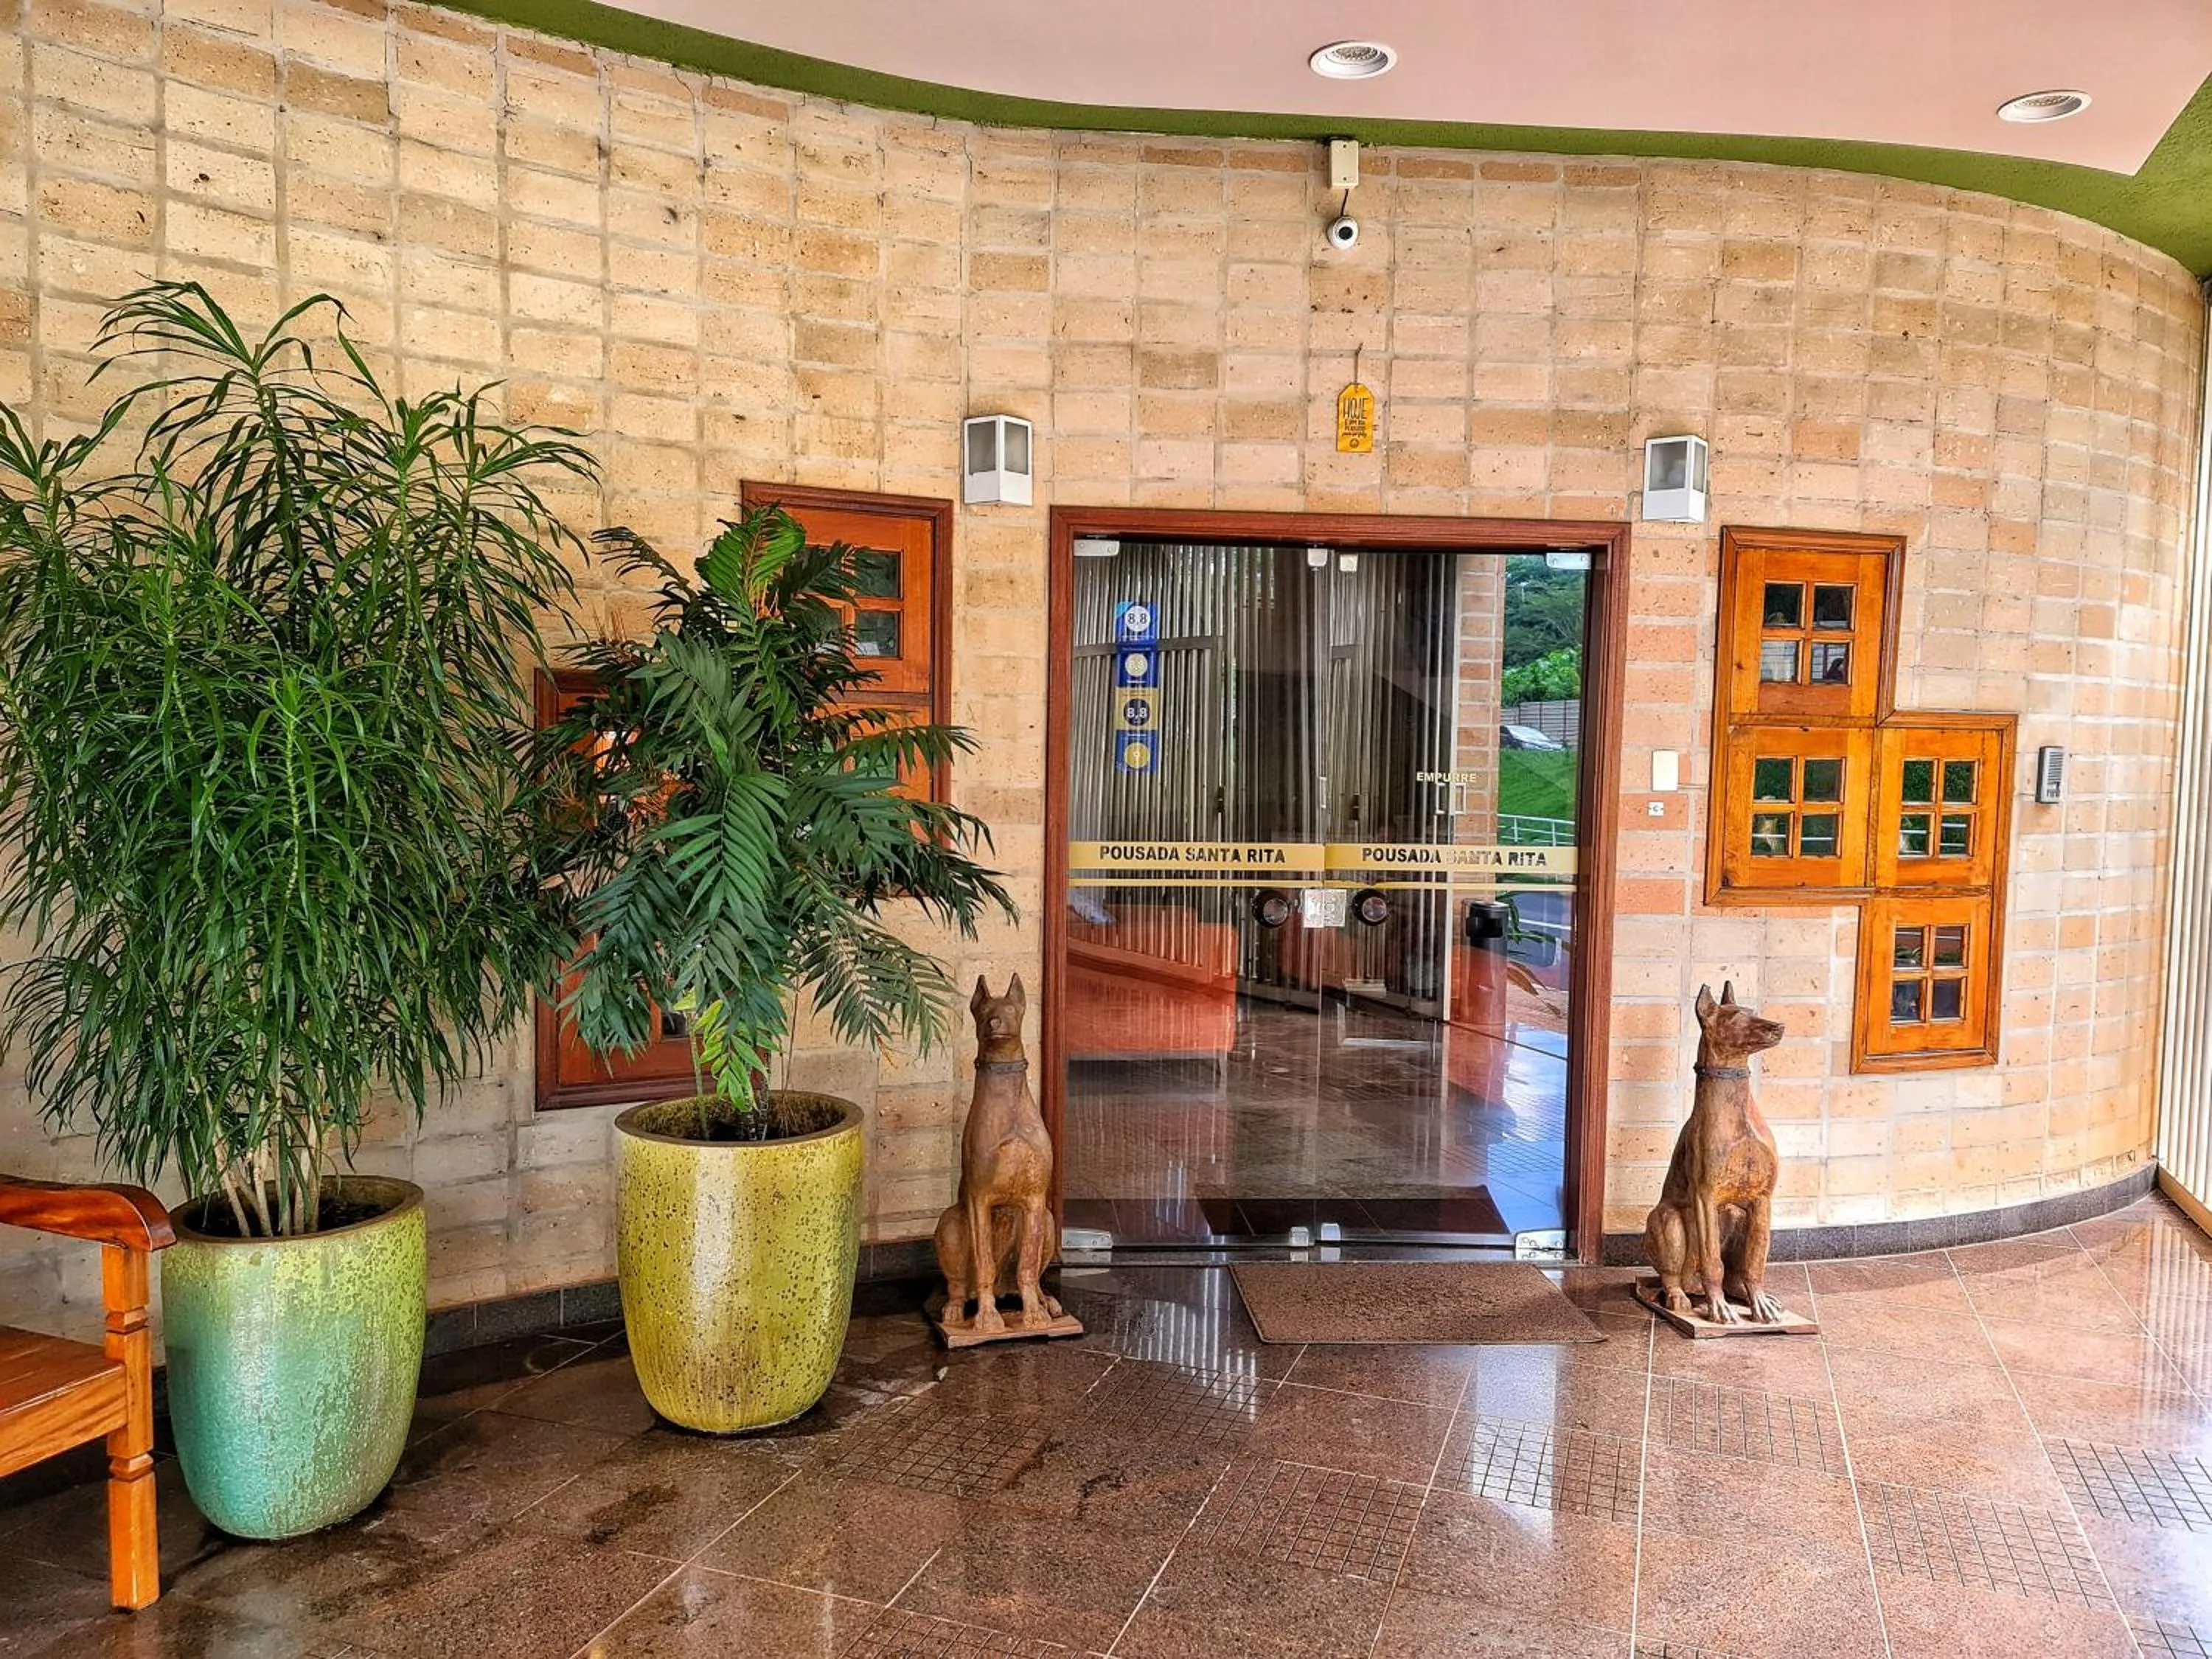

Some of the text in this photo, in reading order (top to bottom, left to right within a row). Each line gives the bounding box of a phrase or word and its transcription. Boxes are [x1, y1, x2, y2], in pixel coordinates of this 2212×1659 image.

[1343, 397, 1369, 420] HOJE
[1127, 613, 1148, 625] 8,8
[1127, 707, 1147, 719] 8,8
[1416, 771, 1477, 783] EMPURRE
[1099, 845, 1286, 863] POUSADA SANTA RITA
[1362, 847, 1441, 863] POUSADA
[1508, 851, 1547, 866] RITA
